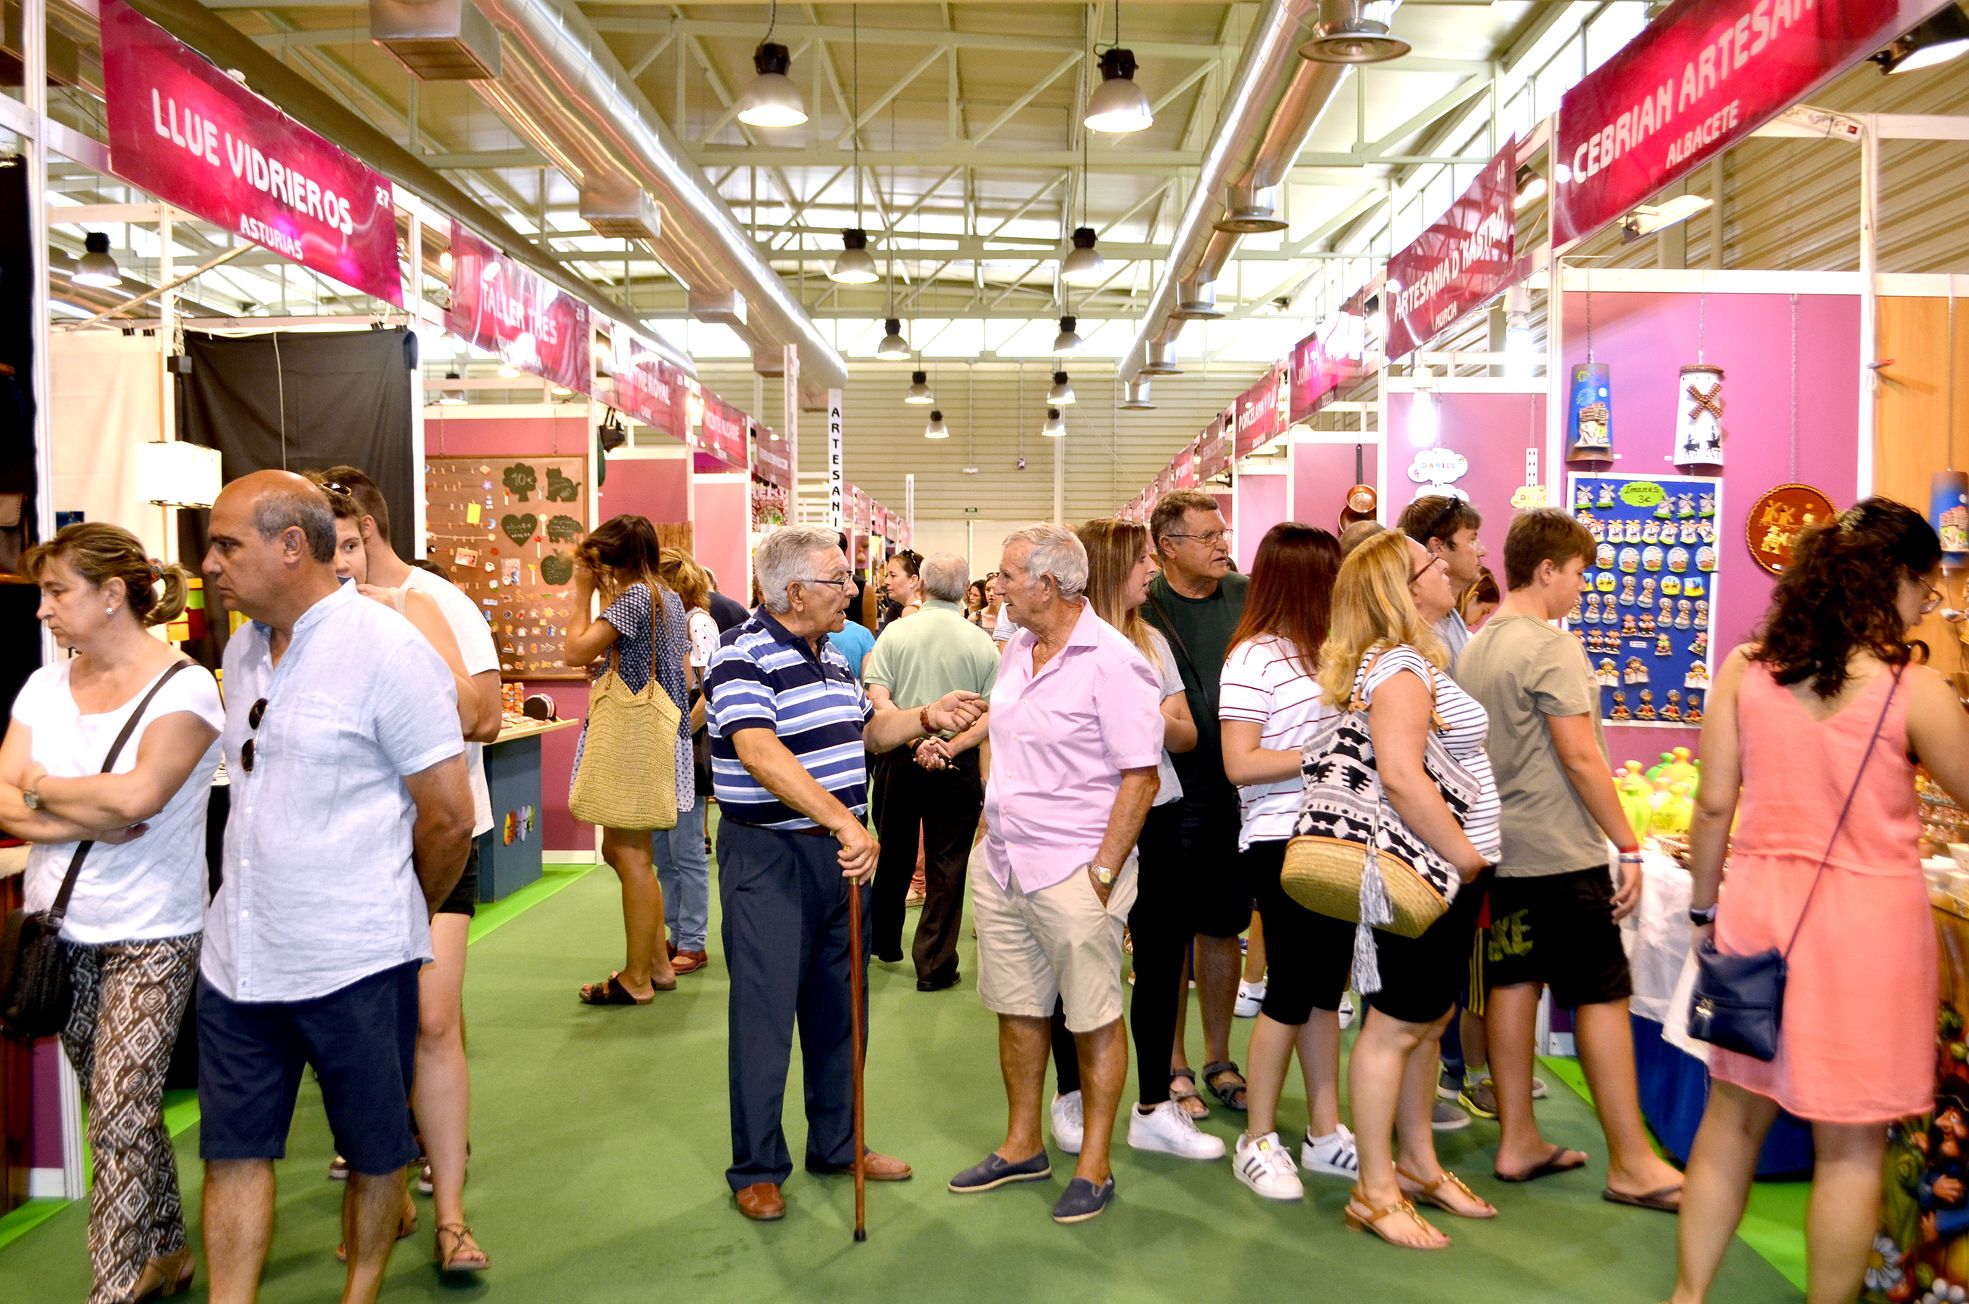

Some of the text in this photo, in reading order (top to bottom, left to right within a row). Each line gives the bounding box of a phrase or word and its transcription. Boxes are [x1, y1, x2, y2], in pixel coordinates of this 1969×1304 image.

[1573, 79, 1673, 184] CEBRIAN
[1666, 99, 1740, 169] ALBACETE
[152, 87, 353, 235] LLUE VIDRIEROS
[1496, 159, 1506, 184] 48
[375, 185, 390, 208] 27
[240, 213, 304, 261] ASTURIAS
[482, 283, 558, 345] TALLER TRES
[576, 307, 586, 322] 28
[1394, 257, 1450, 322] ARTESANIA
[1435, 301, 1457, 331] MURCIA
